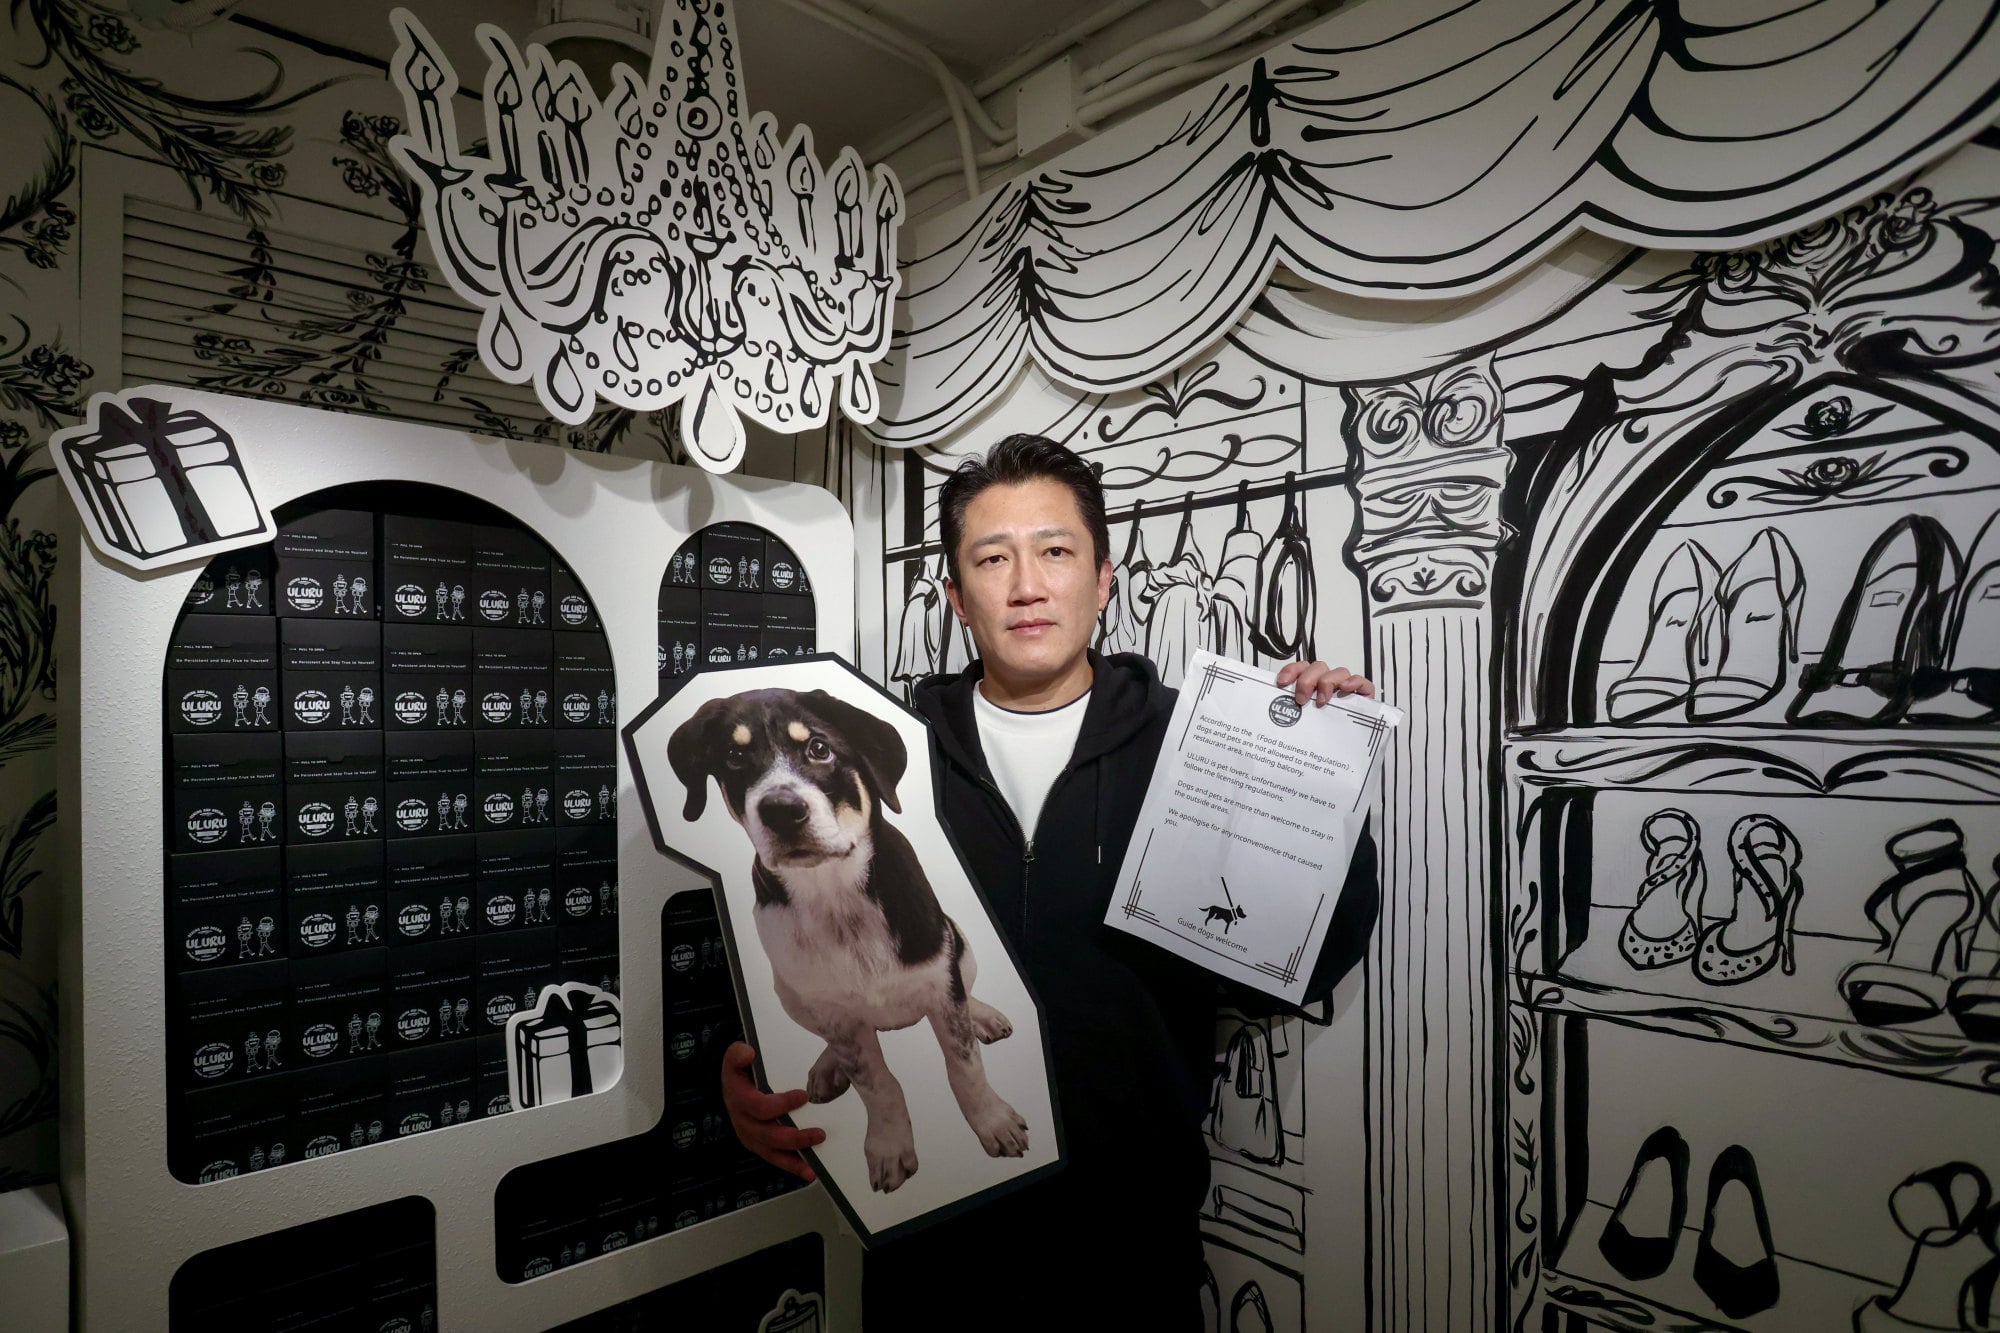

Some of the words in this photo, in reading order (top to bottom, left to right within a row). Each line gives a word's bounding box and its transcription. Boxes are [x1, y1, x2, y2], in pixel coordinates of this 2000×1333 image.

[709, 566, 732, 574] ULURU
[772, 571, 793, 579] ULURU
[287, 587, 323, 598] ULURU
[395, 594, 426, 604] ULURU
[480, 599, 509, 609] ULURU
[560, 604, 587, 614] ULURU
[709, 655, 731, 663] ULURU
[181, 700, 222, 712] ULURU
[294, 700, 330, 711] ULURU
[395, 701, 427, 711] ULURU
[482, 702, 512, 711] ULURU
[563, 702, 590, 711] ULURU
[1271, 703, 1300, 719] ULURU
[1199, 714, 1231, 730] According
[1240, 728, 1252, 736] the
[1277, 740, 1308, 755] Business
[1192, 734, 1226, 749] restaurant
[1226, 745, 1243, 756] area,
[1244, 750, 1276, 768] including
[1276, 761, 1304, 777] balcony.
[1196, 724, 1212, 734] dogs
[1212, 730, 1226, 738] and
[1225, 734, 1241, 743] pets
[1241, 740, 1253, 748] are
[1254, 744, 1266, 752] not
[1266, 748, 1294, 761] allowed
[1302, 761, 1322, 771] enter
[1323, 767, 1335, 776] the
[1183, 760, 1203, 772] follow
[1203, 768, 1215, 777] the
[1215, 771, 1244, 789] licensing
[1244, 783, 1283, 801] regulations.
[1186, 751, 1210, 764] ULURU
[1210, 759, 1216, 767] is
[1216, 763, 1228, 771] pet
[1228, 765, 1249, 779] lovers,
[1250, 775, 1298, 796] unfortunately
[1298, 791, 1309, 799] we
[1309, 794, 1327, 806] have
[1327, 801, 1335, 809] to
[484, 802, 513, 812] ULURU
[564, 798, 591, 808] ULURU
[1174, 789, 1185, 797] the
[1185, 794, 1209, 806] outside
[1210, 803, 1229, 814] areas.
[396, 808, 428, 818] ULURU
[1177, 779, 1194, 791] Dogs
[1194, 787, 1208, 795] and
[1207, 791, 1222, 801] pets
[1222, 797, 1234, 805] are
[1234, 801, 1252, 812] more
[1253, 807, 1269, 818] than
[1270, 814, 1301, 829] welcome
[1310, 829, 1325, 839] stay
[1326, 833, 1333, 841] in
[188, 817, 227, 831] ULURU
[299, 812, 335, 824] ULURU
[1163, 817, 1177, 826] you.
[1168, 807, 1178, 816] We
[1178, 812, 1209, 828] apologise
[1210, 823, 1220, 831] for
[1220, 828, 1233, 838] any
[1232, 831, 1281, 855] inconvenience
[1281, 850, 1296, 861] that
[1296, 857, 1322, 870] caused
[565, 895, 592, 906] ULURU
[487, 904, 516, 914] ULURU
[399, 913, 431, 924] ULURU
[300, 922, 336, 935] ULURU
[1177, 917, 1196, 931] Guide
[1197, 927, 1214, 939] dogs
[1215, 935, 1247, 953] welcome
[186, 935, 226, 949] ULURU
[487, 1003, 516, 1015] ULURU
[398, 1017, 430, 1030] ULURU
[303, 1032, 338, 1046] ULURU
[194, 1050, 233, 1067] ULURU
[488, 1104, 512, 1115] ULUR
[400, 1120, 431, 1135] ULURU
[305, 1143, 340, 1159] ULURU
